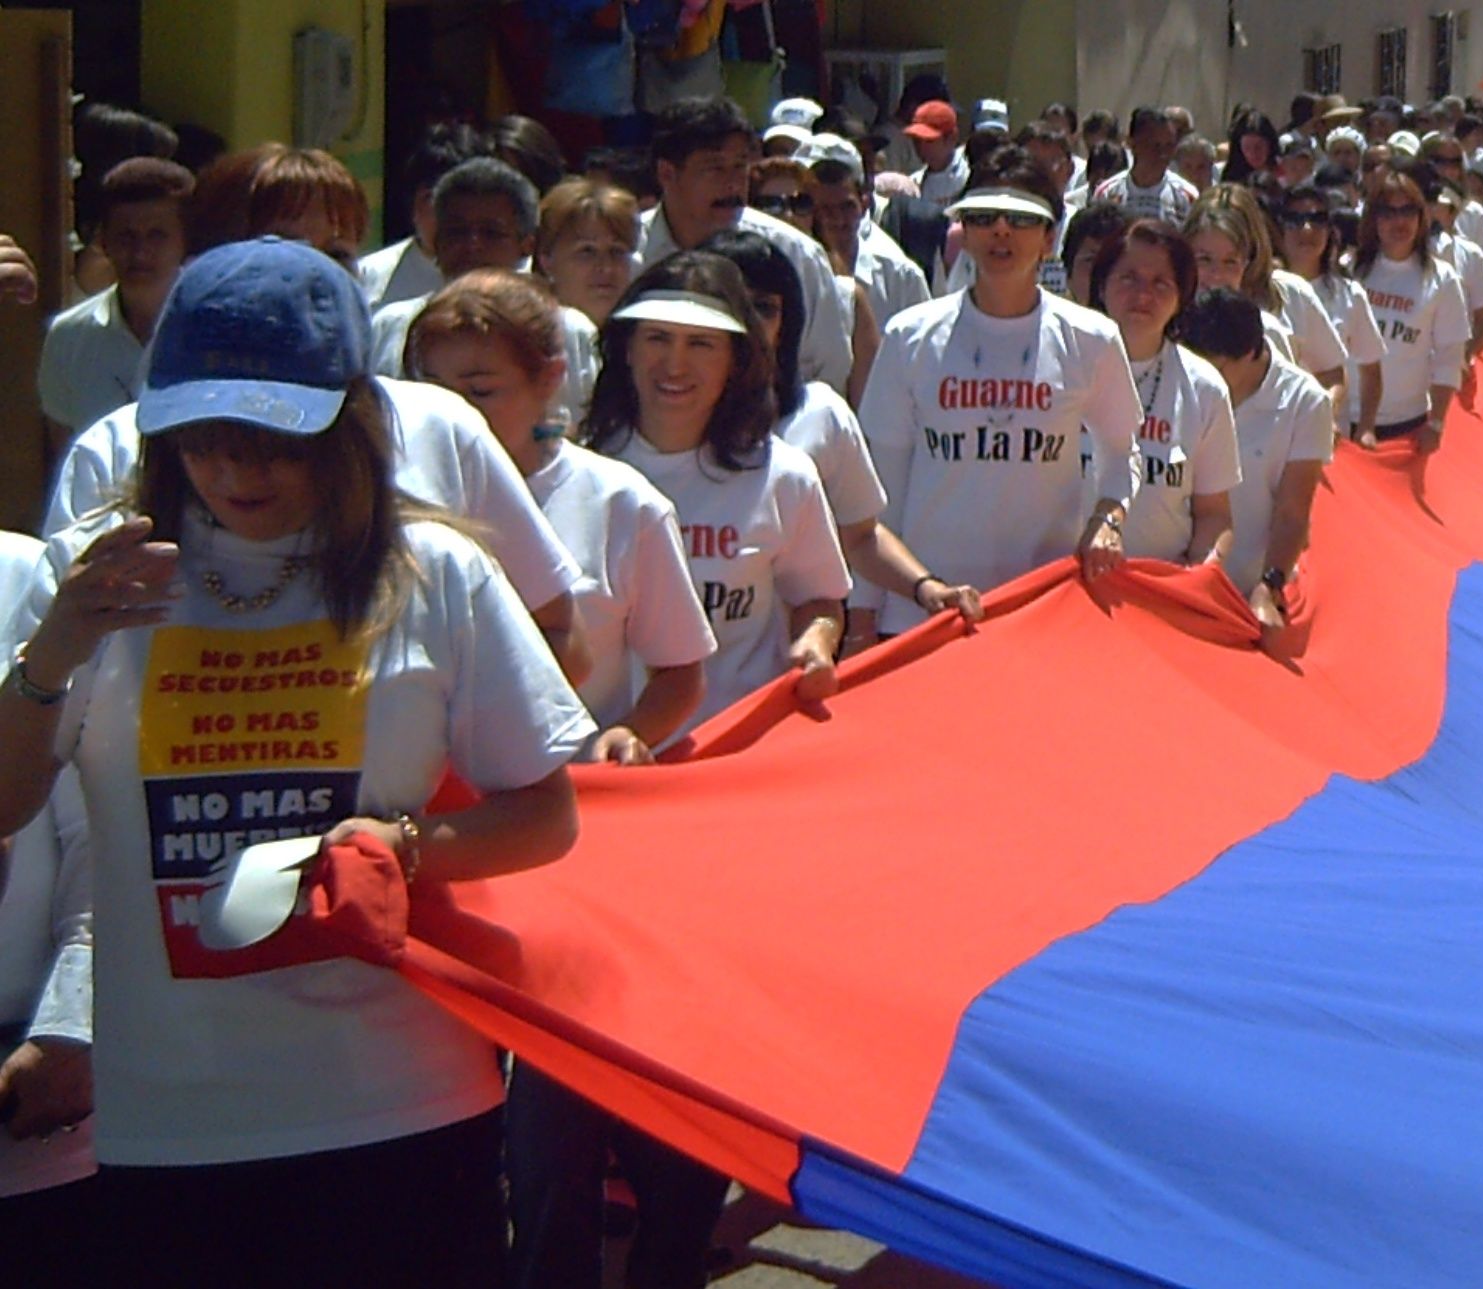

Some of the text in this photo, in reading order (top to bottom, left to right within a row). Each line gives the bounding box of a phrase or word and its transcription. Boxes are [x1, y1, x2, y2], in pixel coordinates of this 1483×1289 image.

[938, 375, 1053, 412] Guarne
[924, 426, 1066, 463] Por La Paz
[703, 582, 755, 621] Paz
[200, 643, 323, 669] NO MAS
[157, 668, 359, 694] SECUESTROS
[192, 711, 321, 735] NO MAS
[170, 739, 340, 766] MENTIRAS
[172, 787, 334, 822] NO MAS
